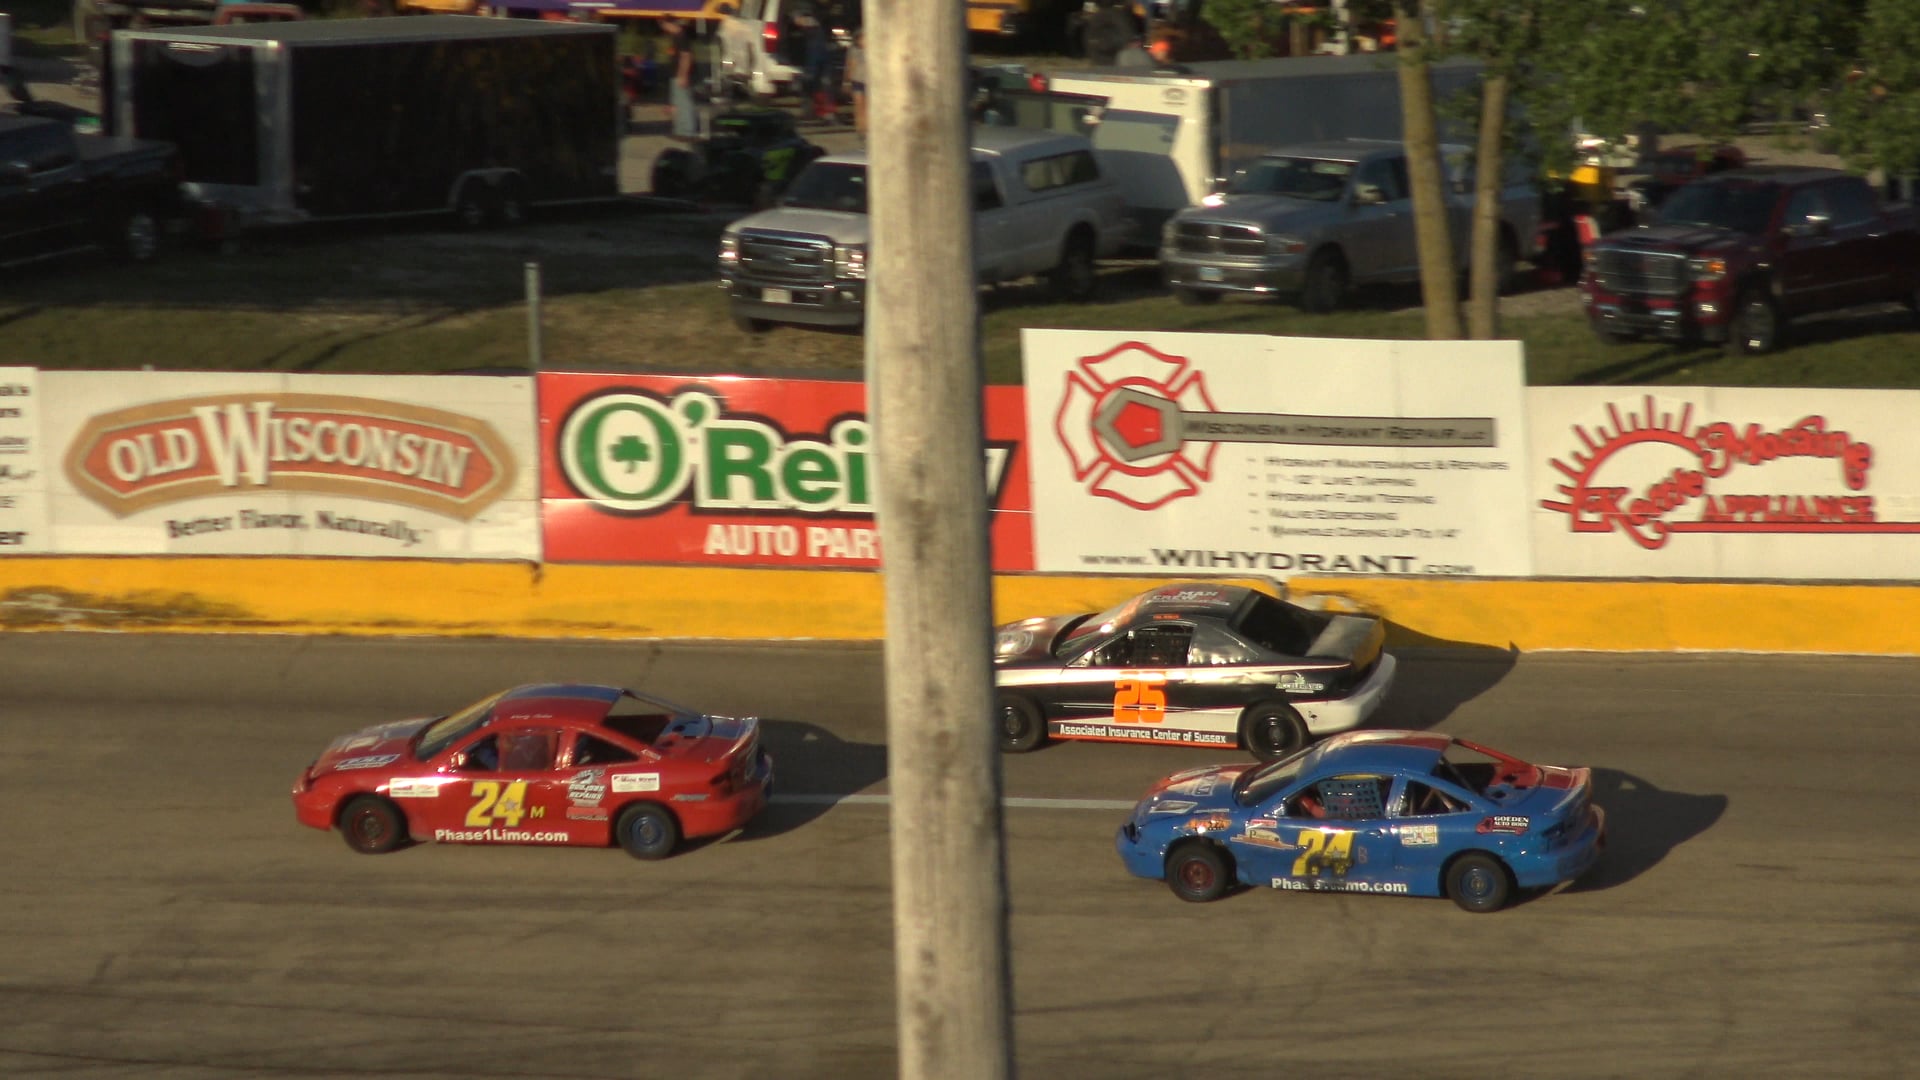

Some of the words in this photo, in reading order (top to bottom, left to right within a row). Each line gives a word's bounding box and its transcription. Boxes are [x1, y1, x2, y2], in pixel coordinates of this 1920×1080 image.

[1295, 422, 1384, 439] HYDRANT
[1387, 425, 1456, 440] REPAIR
[108, 427, 199, 483] OLD
[165, 516, 233, 538] Better
[703, 524, 799, 557] AUTO
[807, 527, 882, 559] PAR
[1113, 671, 1168, 724] 25
[1059, 723, 1106, 736] Associated
[1108, 726, 1151, 739] Insurance
[1152, 729, 1181, 740] Center
[1182, 730, 1193, 741] of
[1194, 731, 1227, 744] Sussex
[465, 780, 529, 827] 24
[530, 805, 546, 819] M
[434, 828, 569, 842] Phase1Limo.com
